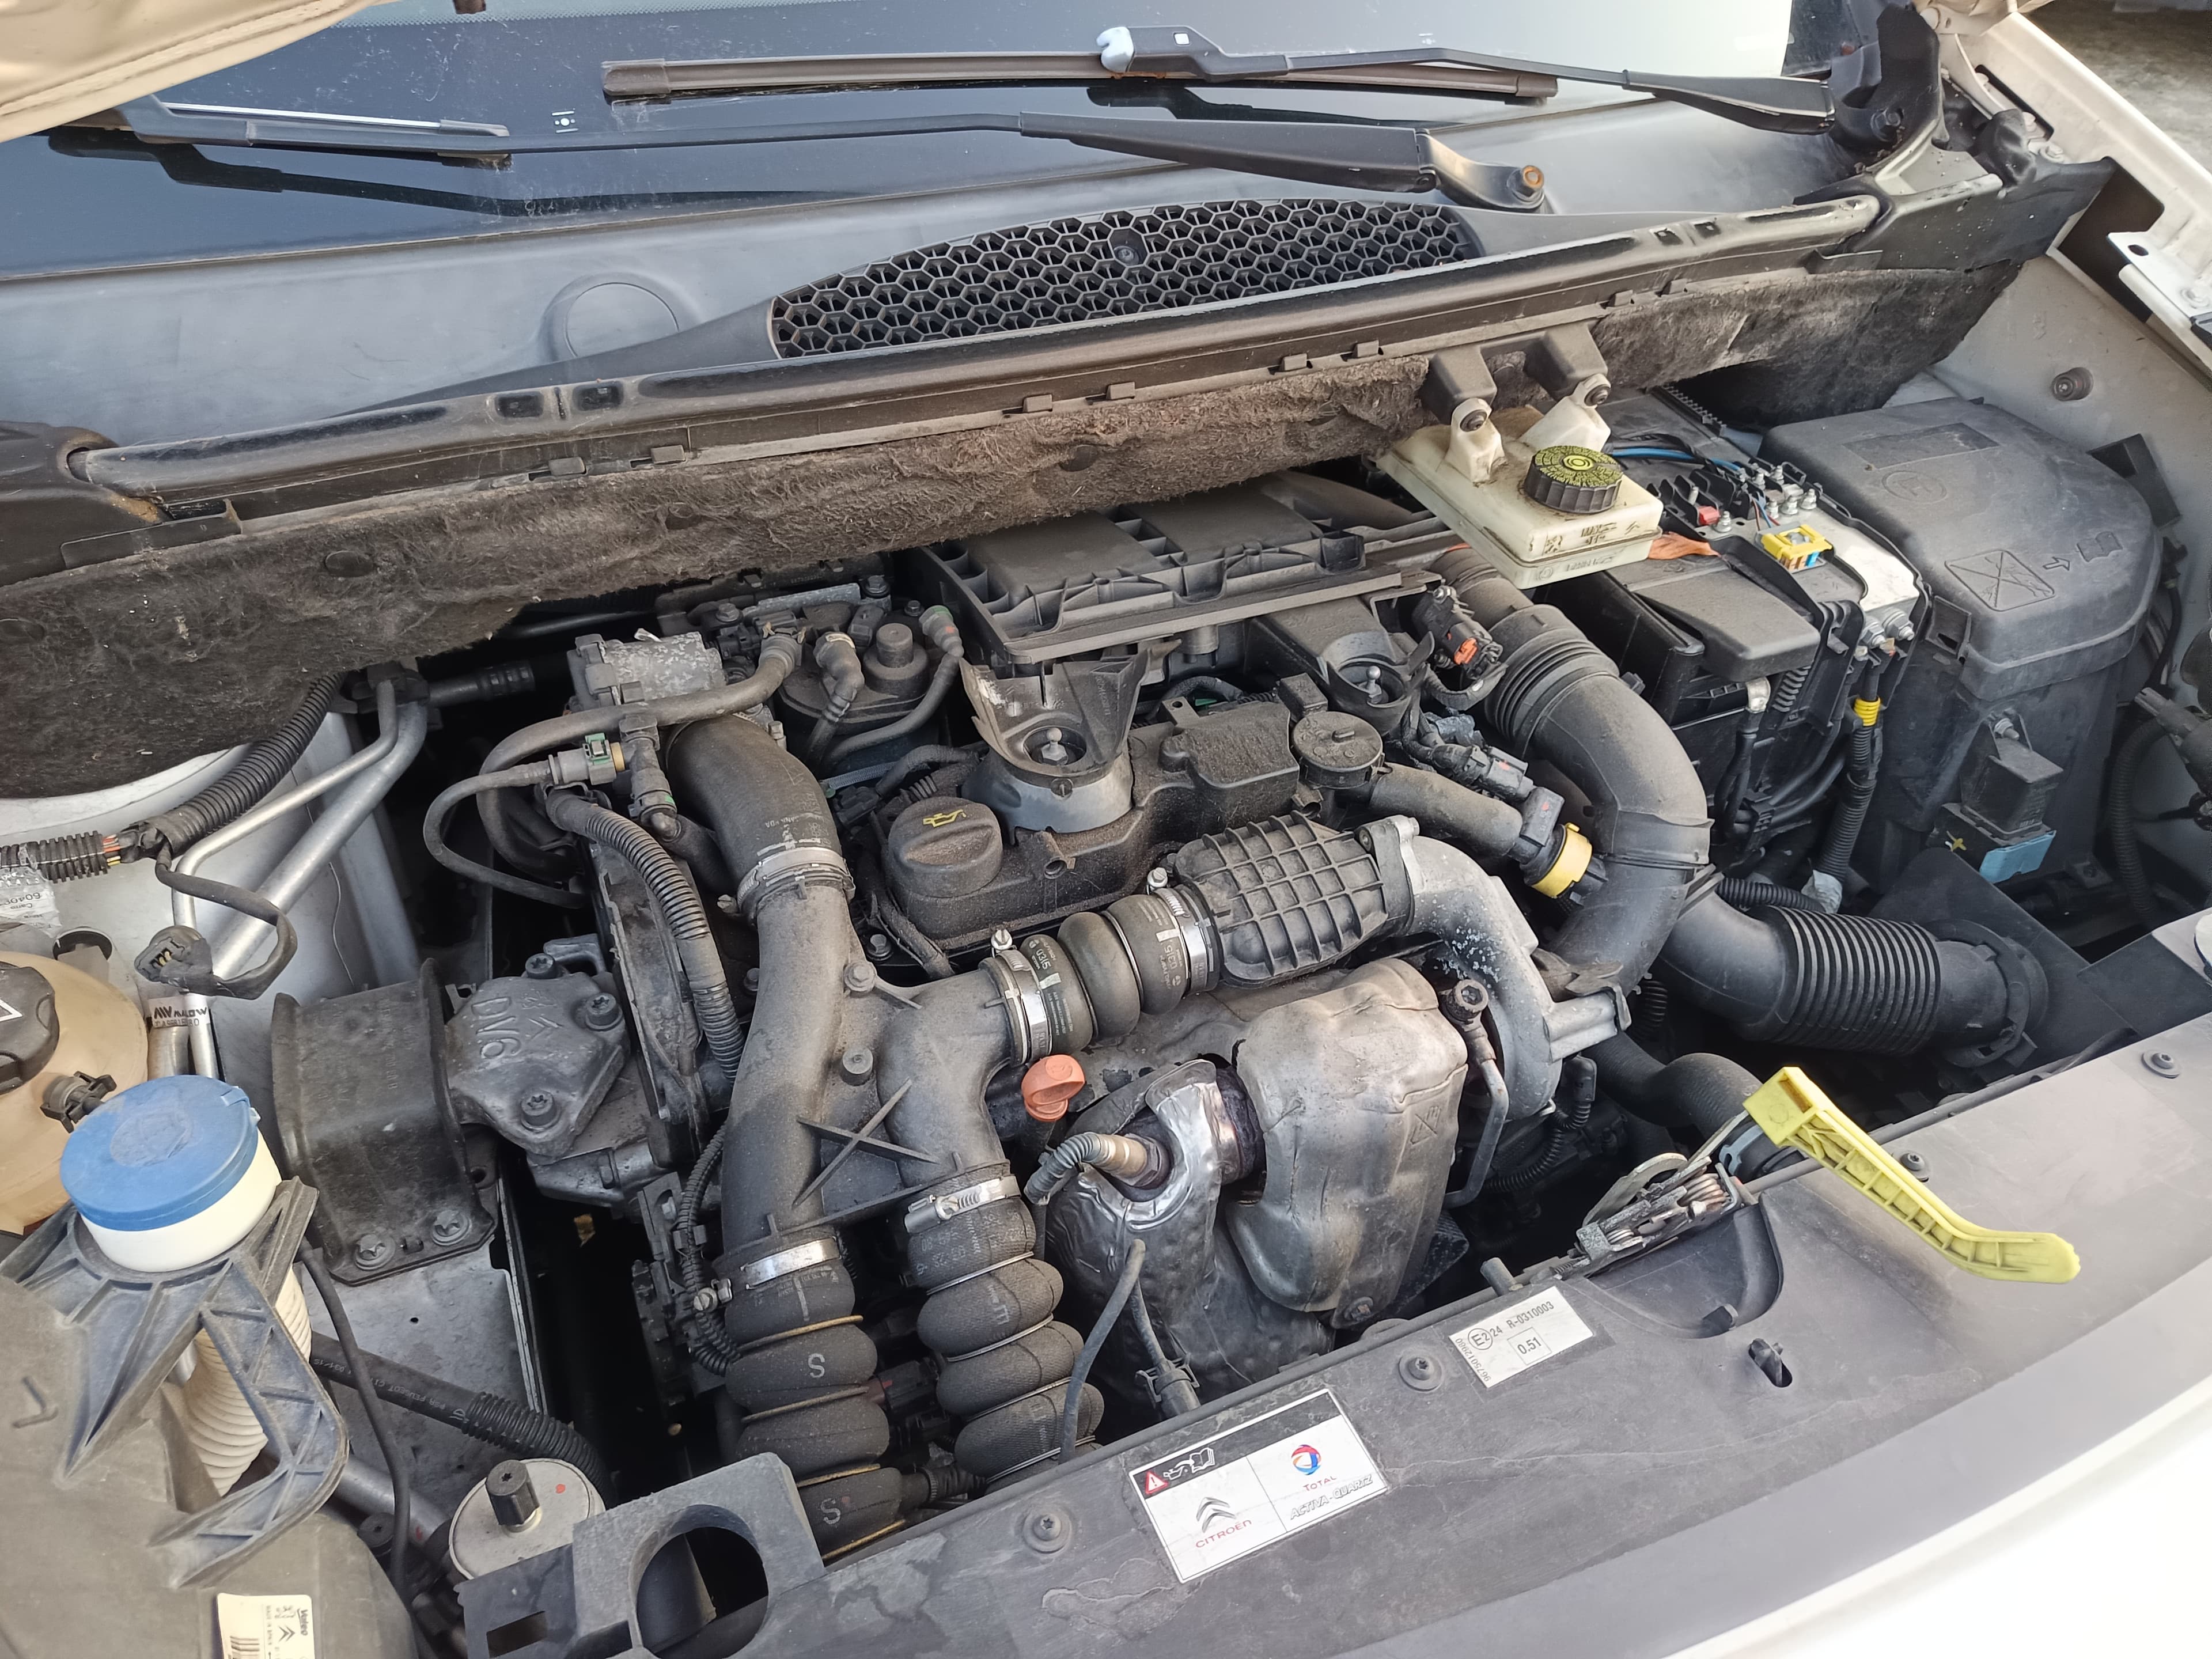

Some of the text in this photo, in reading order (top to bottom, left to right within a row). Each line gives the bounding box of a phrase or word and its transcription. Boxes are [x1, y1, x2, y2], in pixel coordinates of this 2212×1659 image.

[471, 997, 521, 1060] DV6
[1490, 1325, 1503, 1337] 24
[1506, 1301, 1555, 1329] R-0310003
[1455, 1338, 1492, 1382] 9675012980
[1517, 1336, 1542, 1355] 0.51
[808, 1354, 825, 1378] S
[820, 1498, 841, 1524] S
